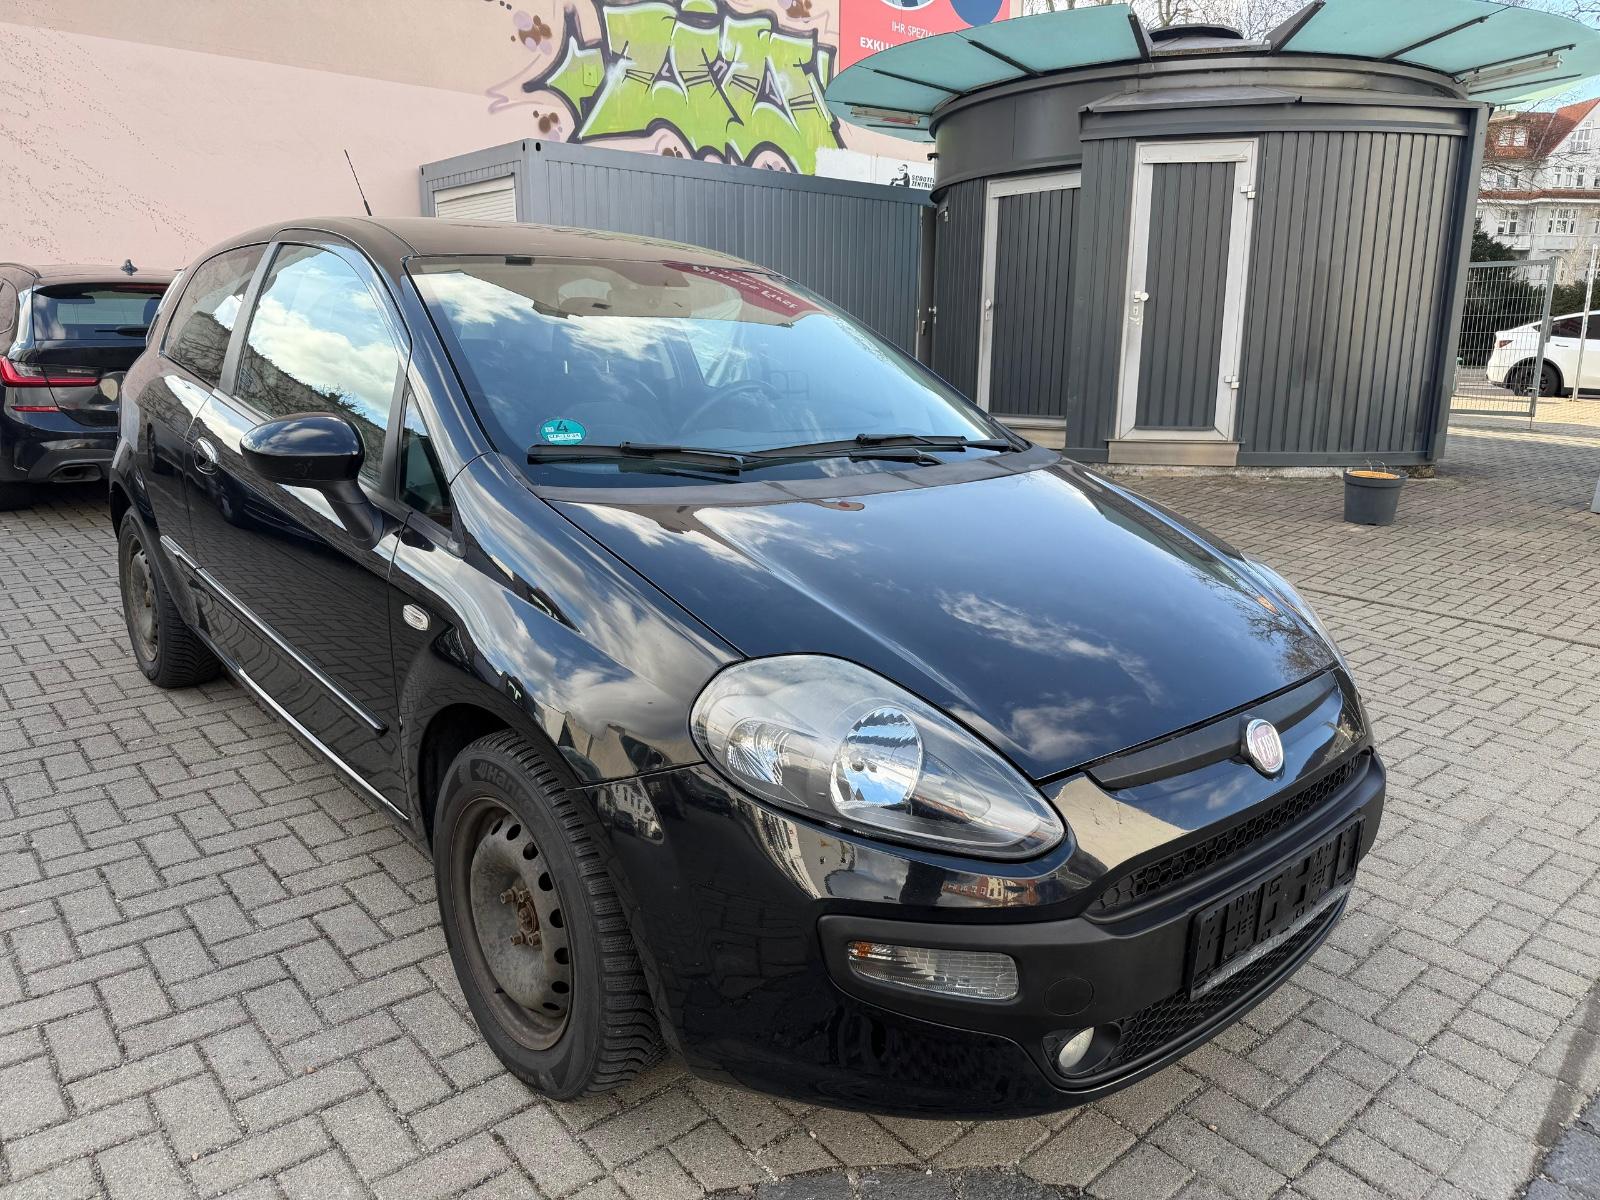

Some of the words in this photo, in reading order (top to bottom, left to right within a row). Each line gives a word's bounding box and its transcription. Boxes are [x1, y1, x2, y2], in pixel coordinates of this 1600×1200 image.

[891, 20, 906, 34] IHR
[907, 25, 936, 38] SPEZI
[556, 420, 569, 433] 4
